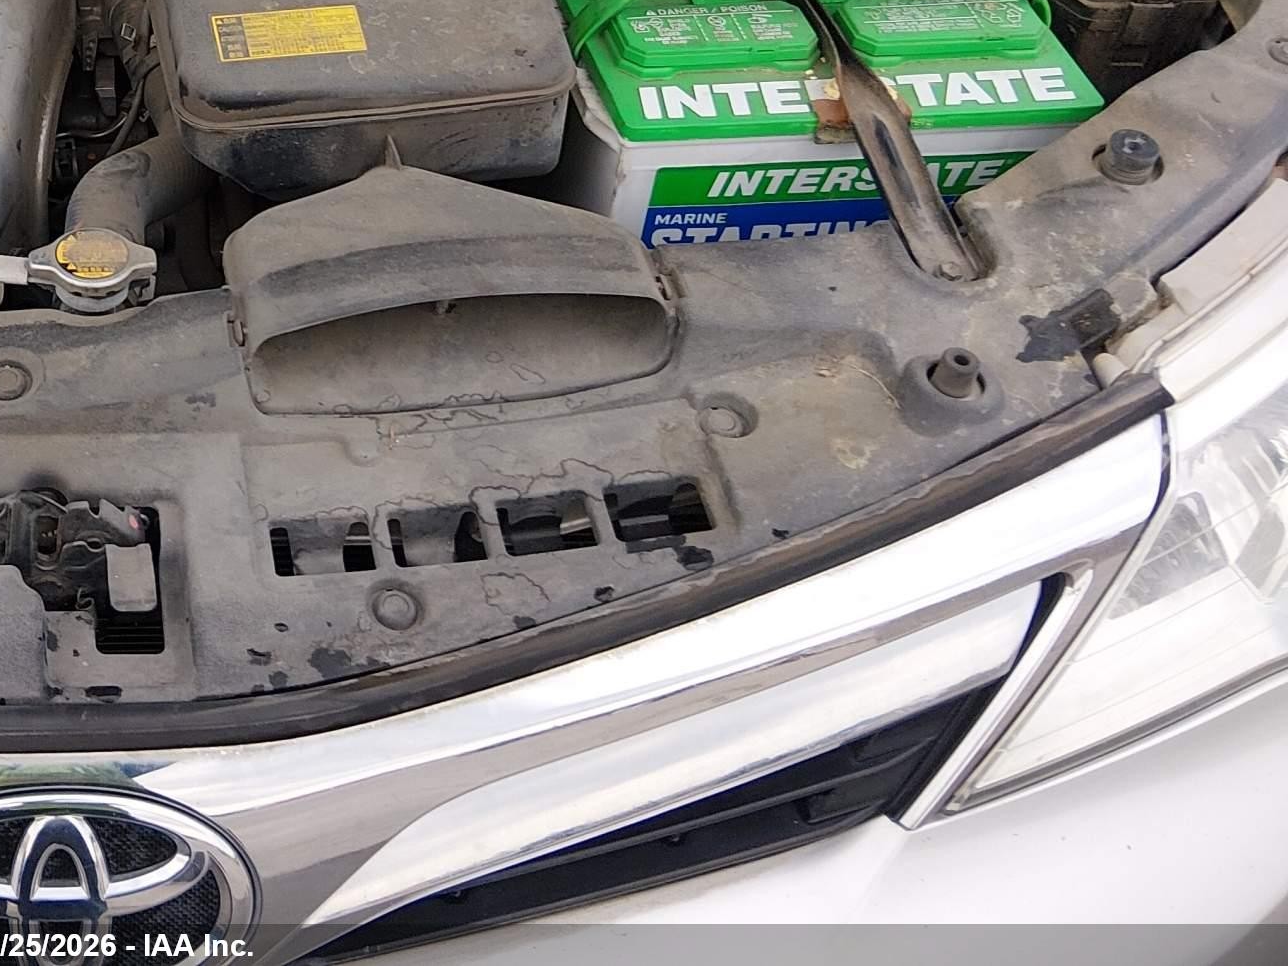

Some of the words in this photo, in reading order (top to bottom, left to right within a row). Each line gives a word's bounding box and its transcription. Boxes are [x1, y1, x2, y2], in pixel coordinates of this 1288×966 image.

[657, 7, 710, 16] DANGER
[719, 4, 768, 14] POISON
[638, 66, 1077, 120] INTETATE
[707, 159, 1006, 198] INTERSTE
[654, 212, 728, 225] MARINE
